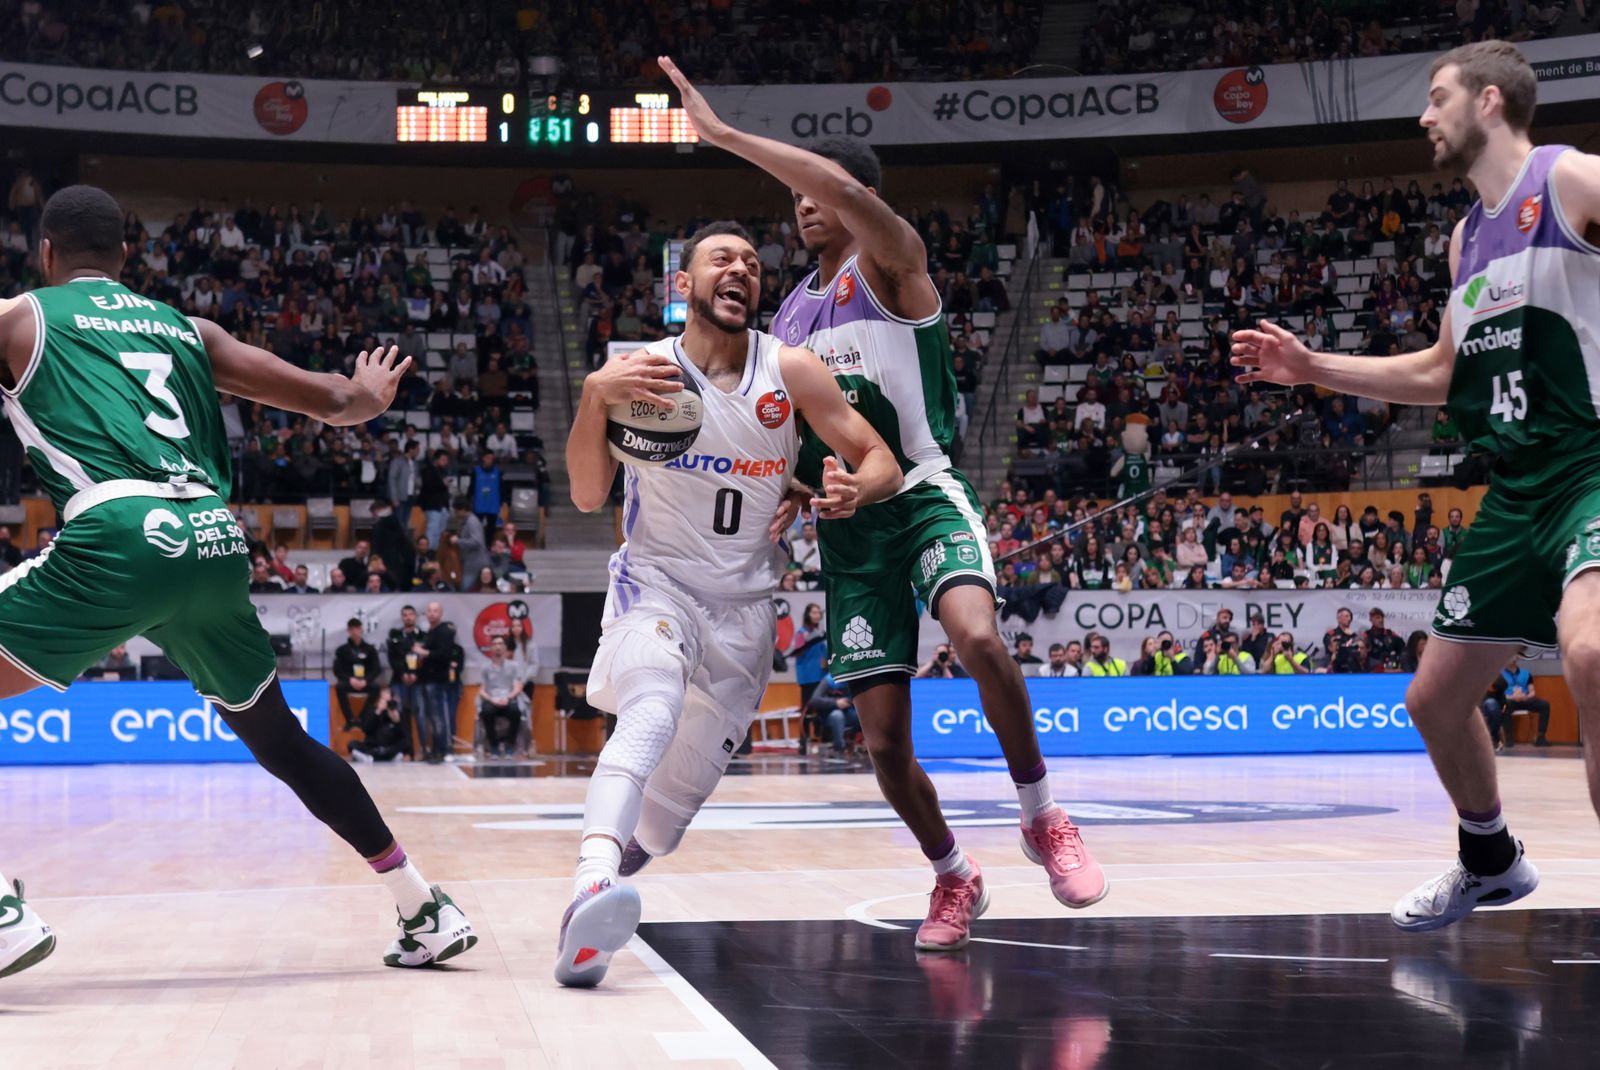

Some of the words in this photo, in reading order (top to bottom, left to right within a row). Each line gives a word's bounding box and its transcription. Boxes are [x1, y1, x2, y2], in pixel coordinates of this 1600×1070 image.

[1568, 63, 1582, 74] de
[0, 73, 198, 116] CopaACB
[502, 93, 514, 114] 0
[579, 94, 590, 115] 3
[934, 83, 1160, 125] #CopaACB
[499, 121, 508, 142] 1
[587, 121, 599, 142] 0
[791, 107, 873, 138] acb
[90, 294, 157, 311] EJIM
[119, 352, 191, 439] 3
[1490, 370, 1527, 422] 45
[665, 453, 787, 477] AUTOHERO
[713, 487, 743, 535] 0
[194, 527, 227, 543] DEL
[226, 524, 246, 541] SO
[1074, 602, 1167, 630] COPA
[1246, 602, 1305, 629] REY
[932, 707, 1079, 734] ensa
[1104, 698, 1248, 732] endesa
[1272, 696, 1413, 729] endesa
